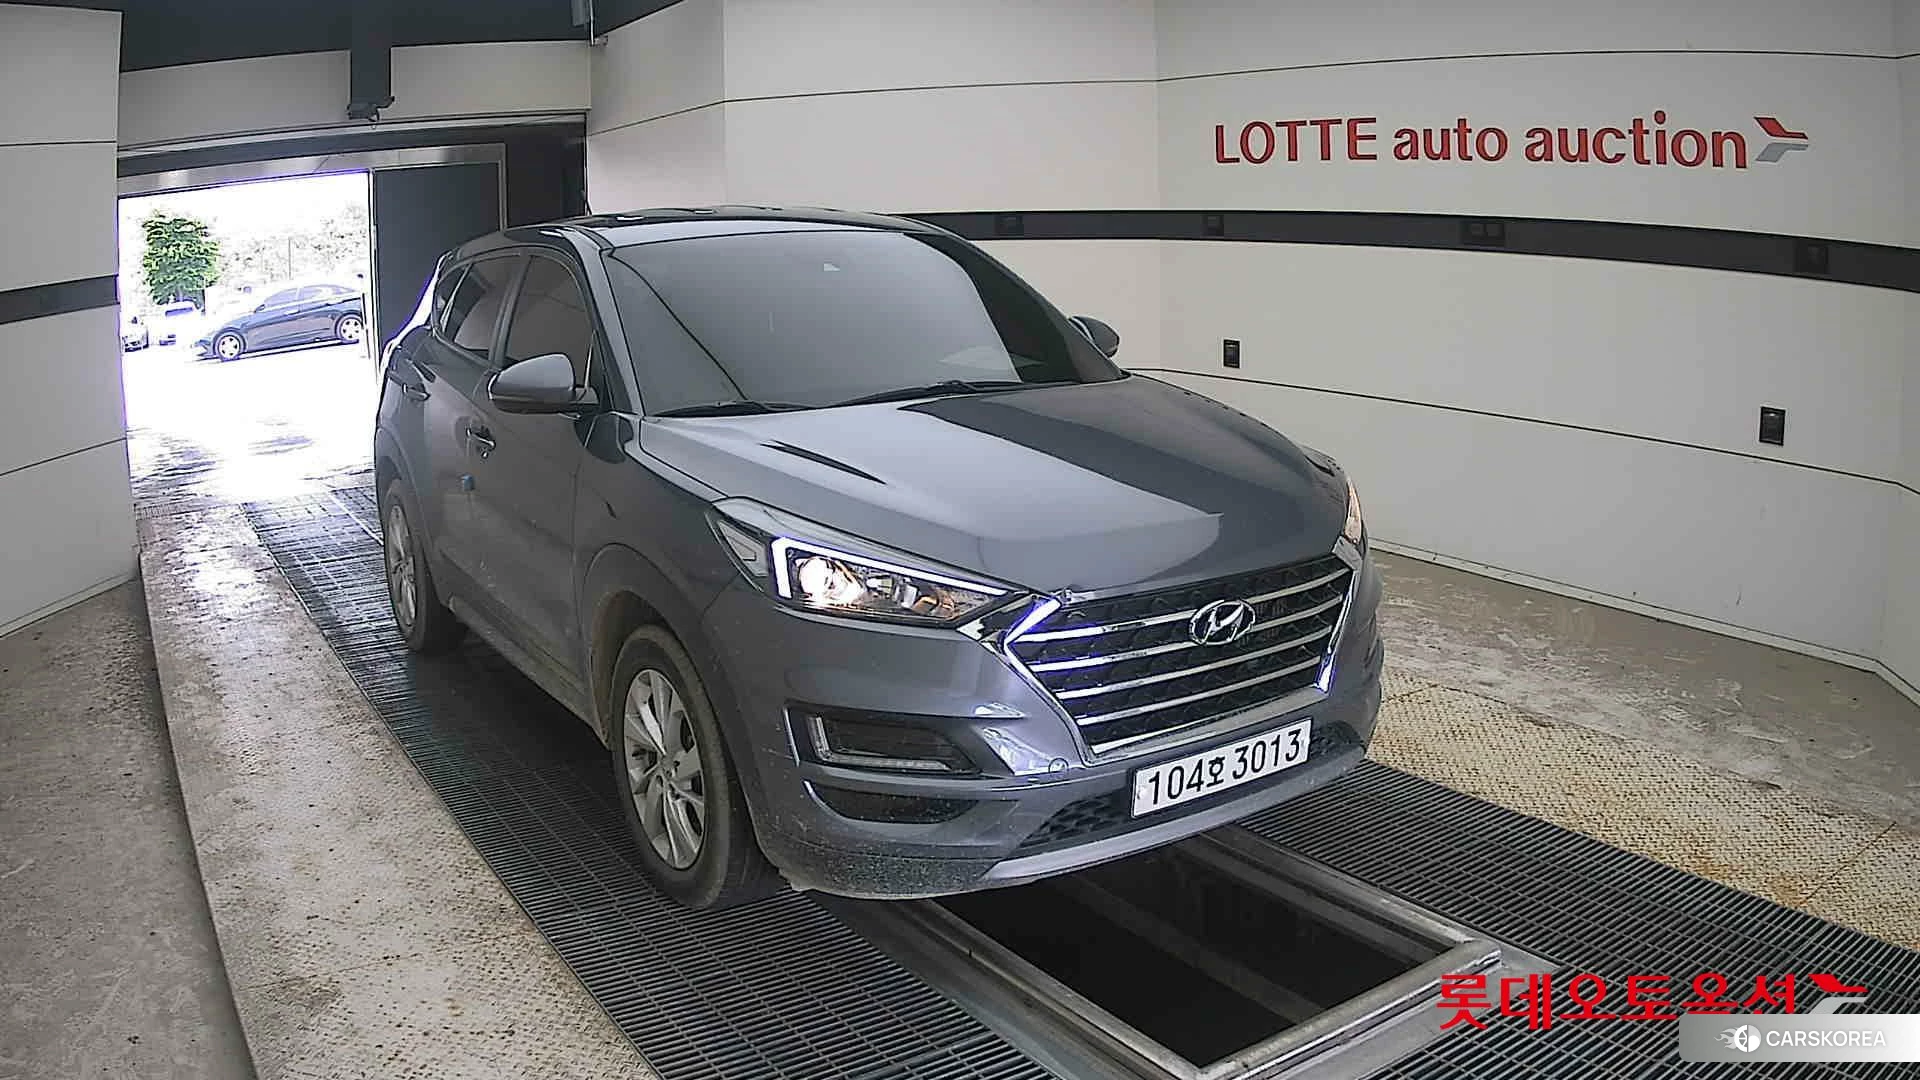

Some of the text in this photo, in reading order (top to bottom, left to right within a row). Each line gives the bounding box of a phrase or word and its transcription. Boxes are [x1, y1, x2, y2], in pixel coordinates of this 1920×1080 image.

[1215, 110, 1747, 169] LOTTE auto auction
[1149, 728, 1302, 805] 104호 3013
